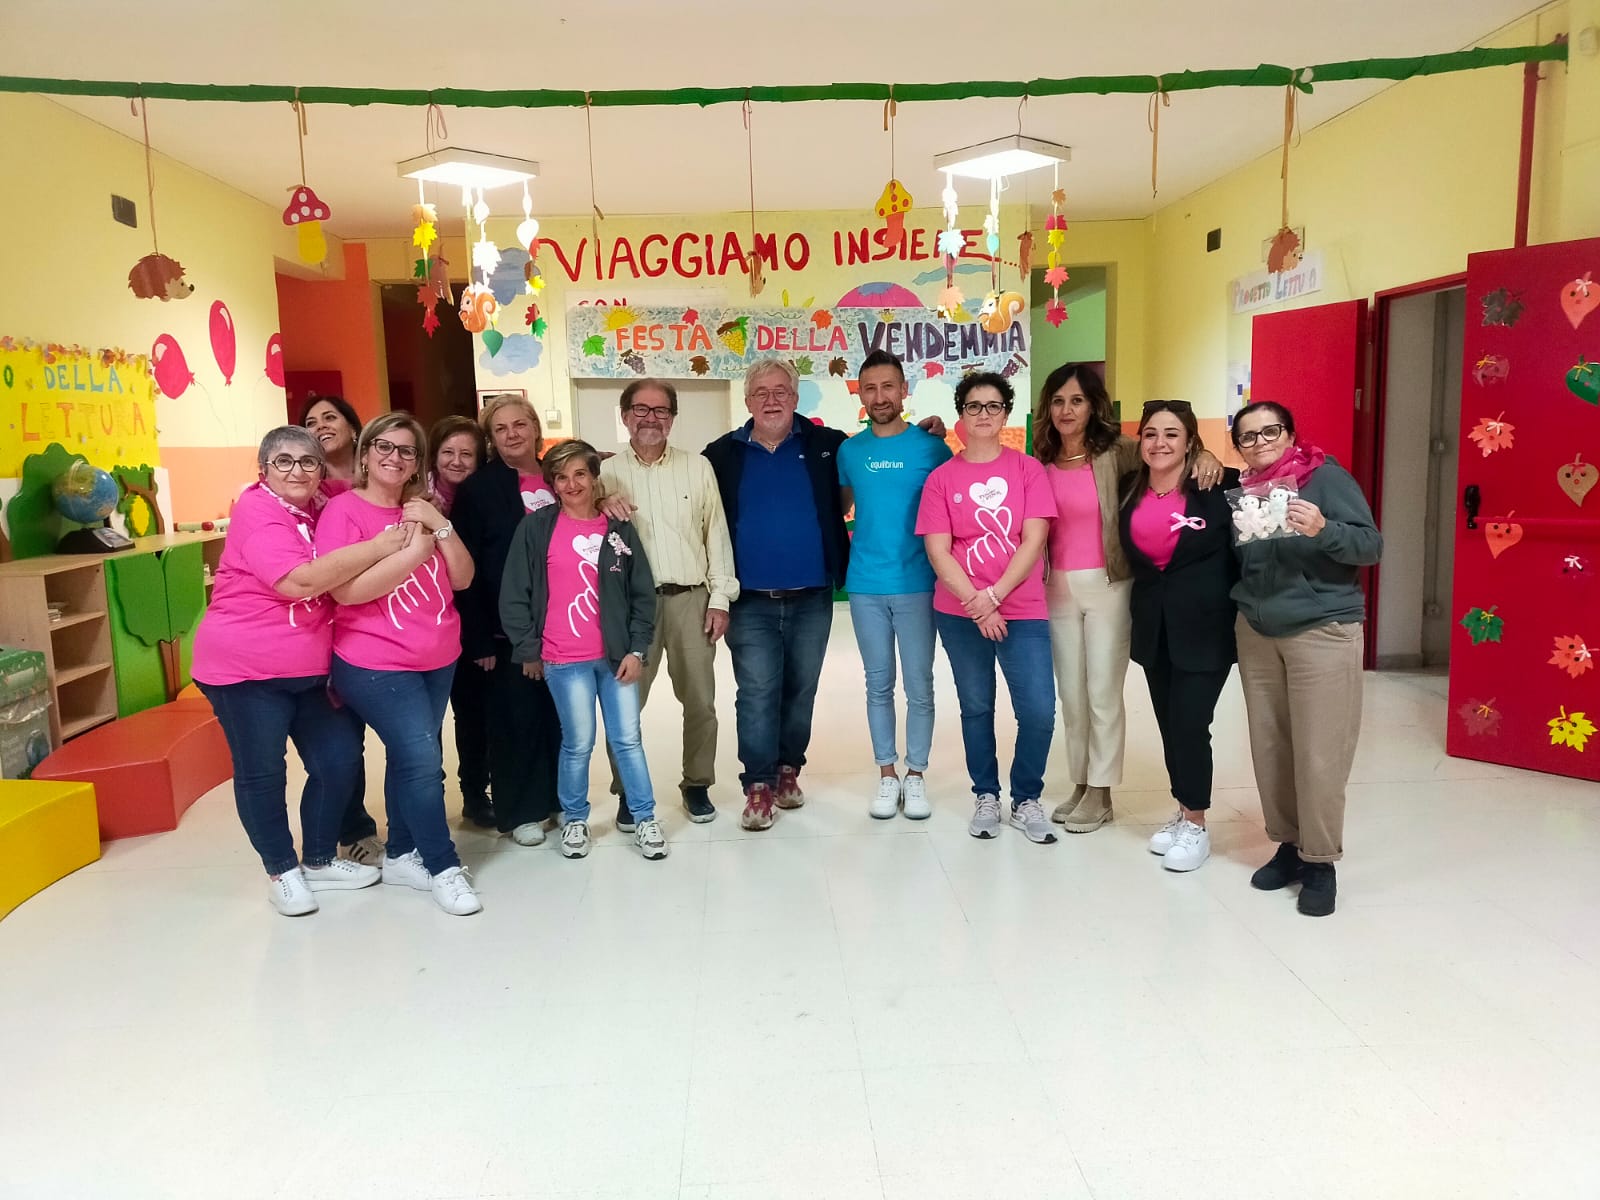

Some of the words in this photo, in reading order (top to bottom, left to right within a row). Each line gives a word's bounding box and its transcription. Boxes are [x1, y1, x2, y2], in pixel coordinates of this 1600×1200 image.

[538, 232, 810, 282] VIAGGIAMO
[834, 228, 1001, 266] INSIEE
[1275, 267, 1316, 299] LETTUA
[616, 324, 713, 351] FESTA
[757, 325, 848, 351] DELLA
[858, 321, 1026, 362] VENDEMMIA
[44, 364, 124, 394] DELLA
[21, 402, 146, 441] LETTUA
[870, 460, 904, 470] equilibrium
